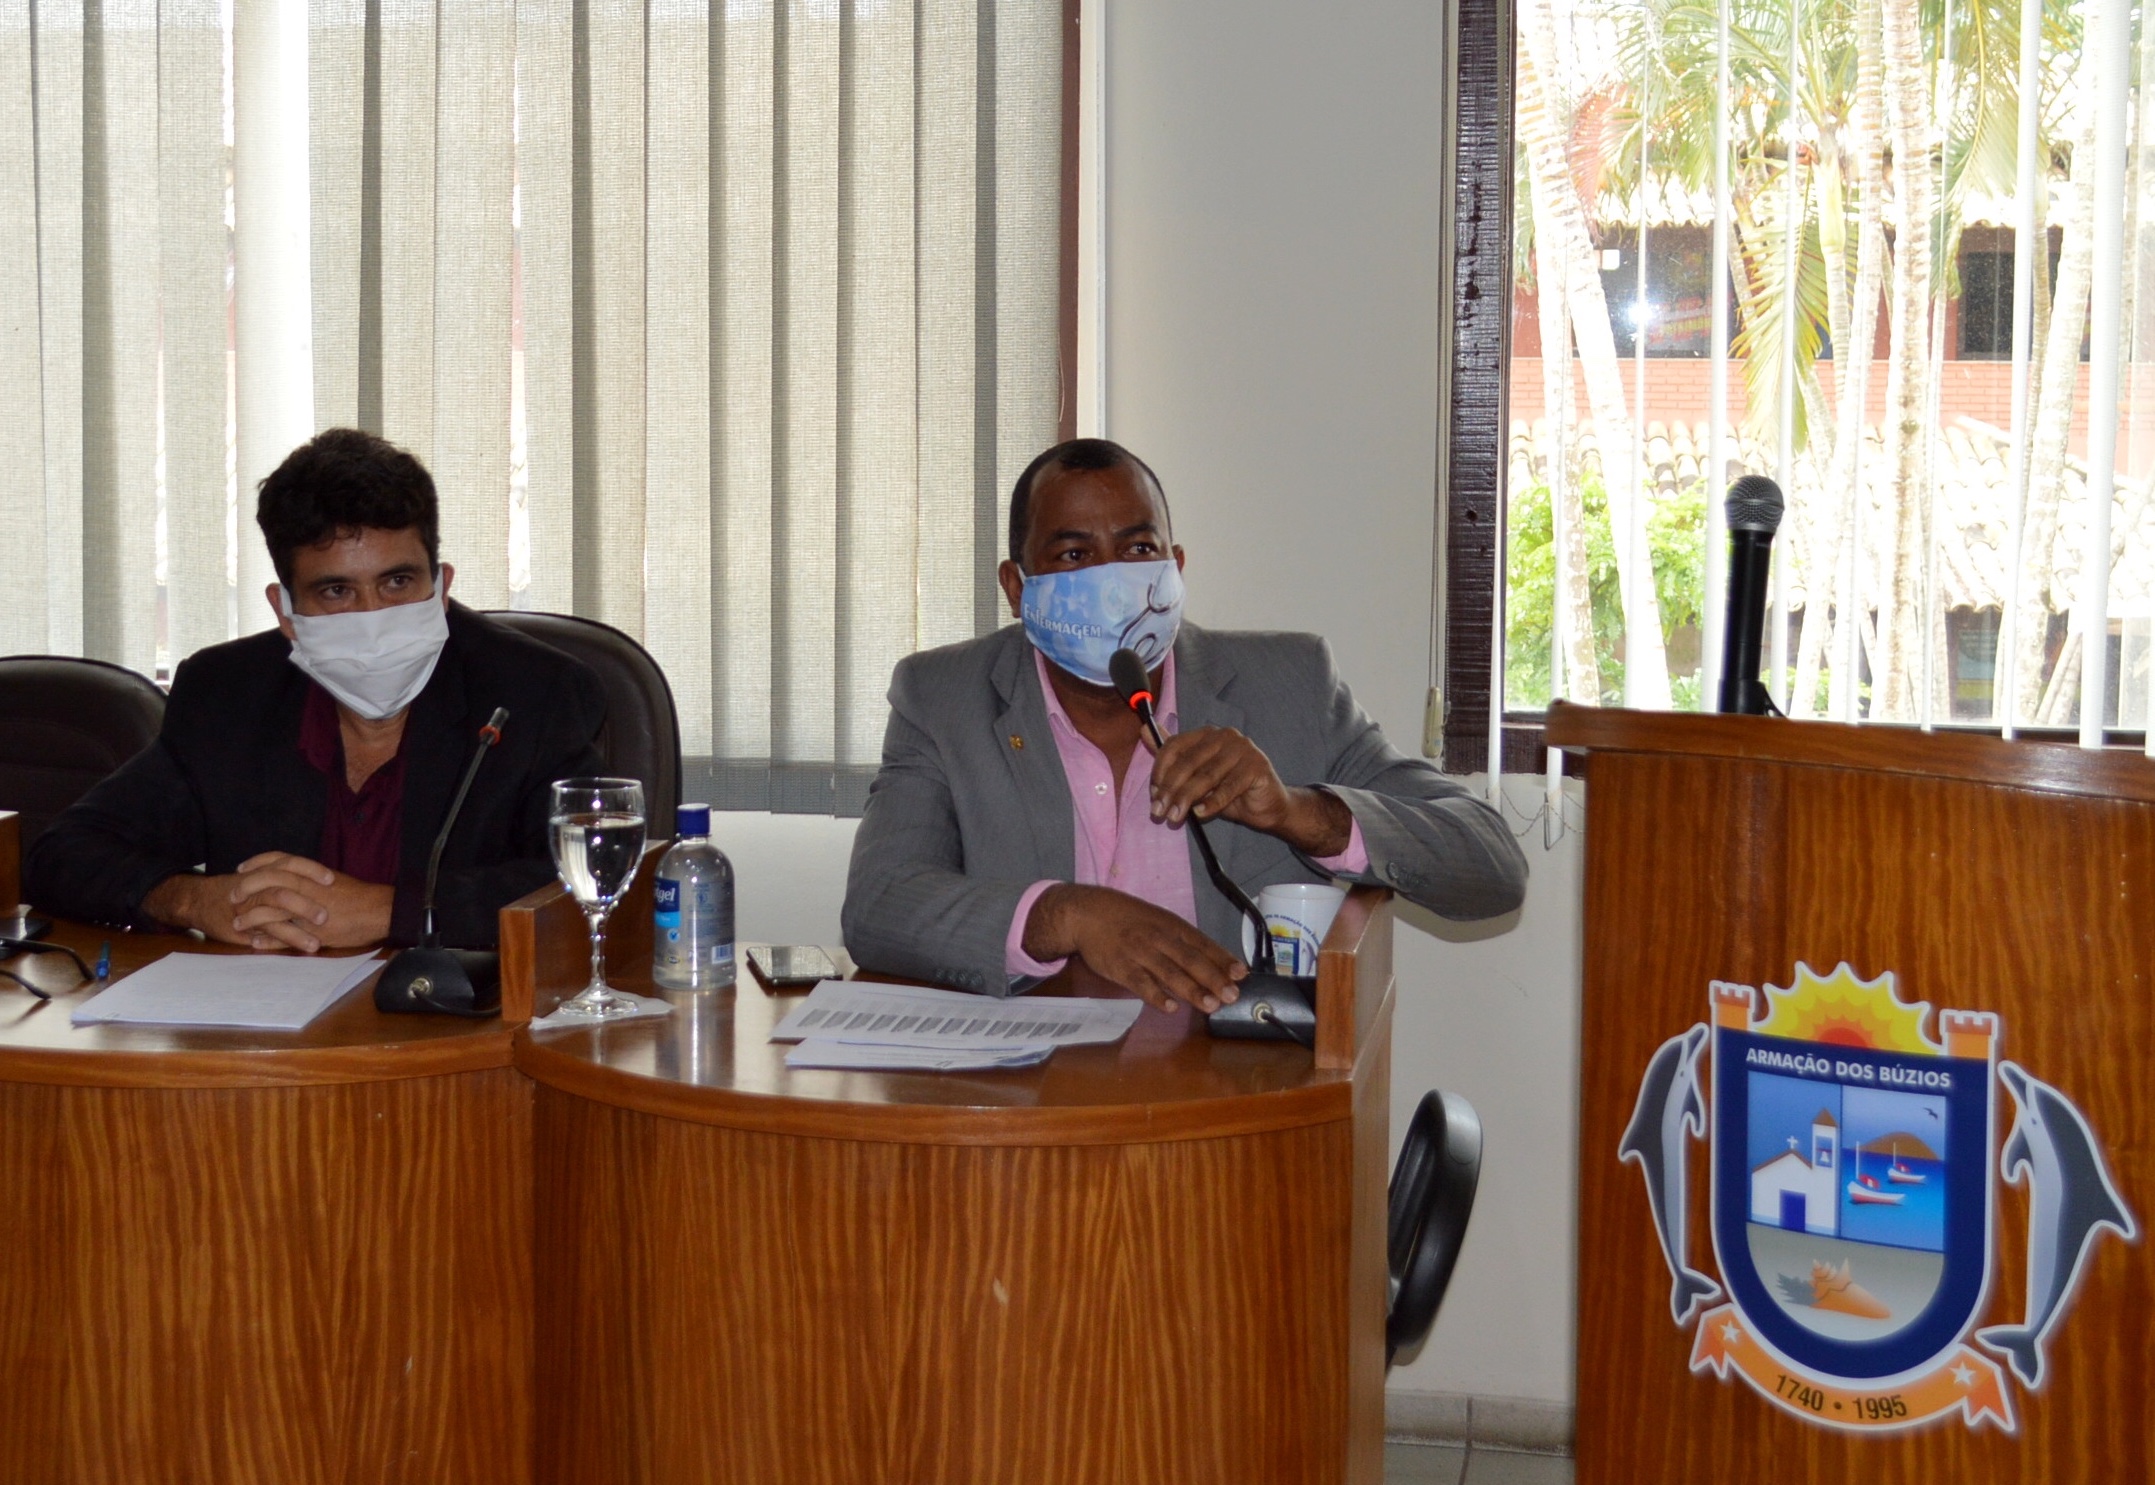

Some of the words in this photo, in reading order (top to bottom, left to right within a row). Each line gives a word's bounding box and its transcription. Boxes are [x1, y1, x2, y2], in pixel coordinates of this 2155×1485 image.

[1745, 1047, 1830, 1075] ARMAÇÃO
[1835, 1060, 1875, 1080] DOS
[1879, 1063, 1951, 1088] BÚZIOS
[1776, 1374, 1825, 1412] 1740
[1852, 1394, 1908, 1420] 1995
